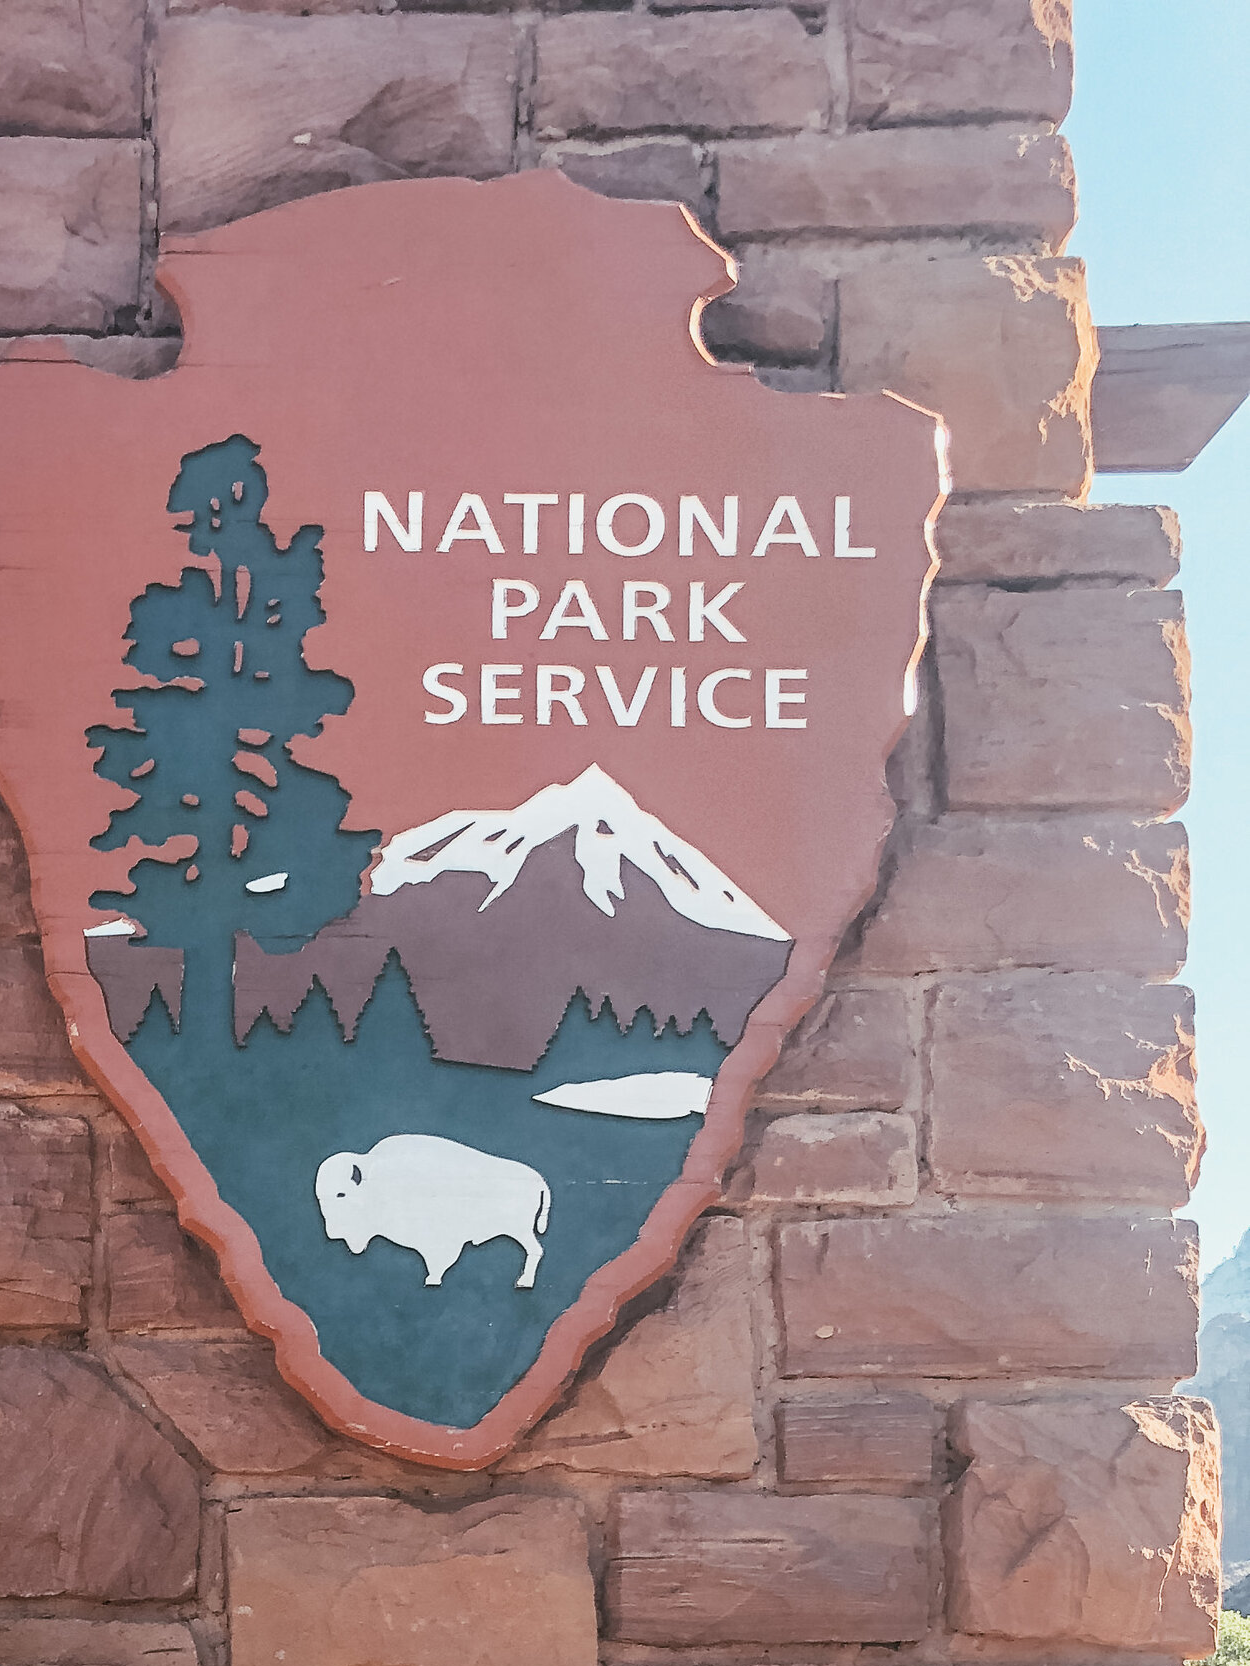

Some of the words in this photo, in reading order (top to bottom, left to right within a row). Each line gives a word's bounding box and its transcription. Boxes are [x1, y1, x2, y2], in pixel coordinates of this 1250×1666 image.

[362, 490, 877, 559] NATIONAL
[490, 578, 748, 643] PARK
[421, 662, 809, 729] SERVICE
